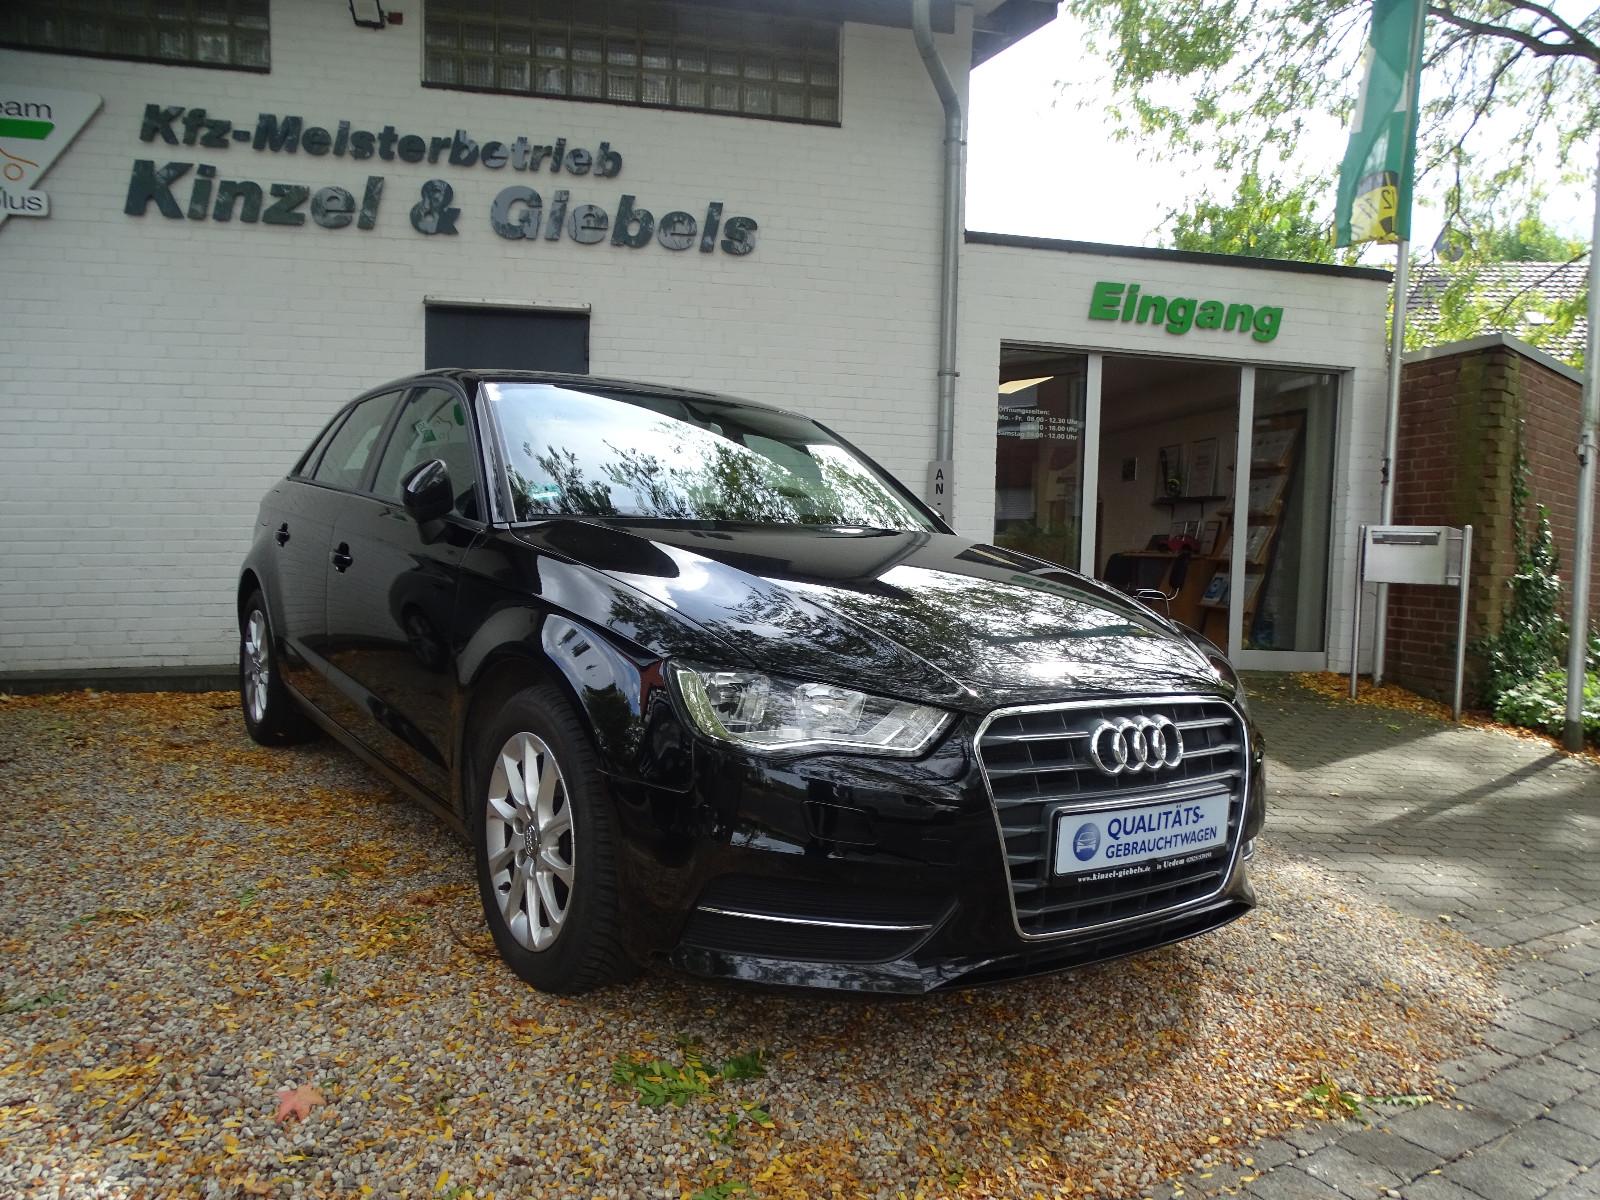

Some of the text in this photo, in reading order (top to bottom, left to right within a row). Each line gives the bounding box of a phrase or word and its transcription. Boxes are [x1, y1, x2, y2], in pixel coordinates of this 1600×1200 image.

[0, 100, 52, 118] am
[139, 103, 623, 178] Kfz-Meisterbetrieb
[124, 159, 758, 256] Kinzel & Giebels
[1089, 281, 1284, 343] Eingang
[1105, 826, 1218, 859] GEBRAUCHTWAGEN
[1107, 804, 1205, 841] QUALITÄTS-
